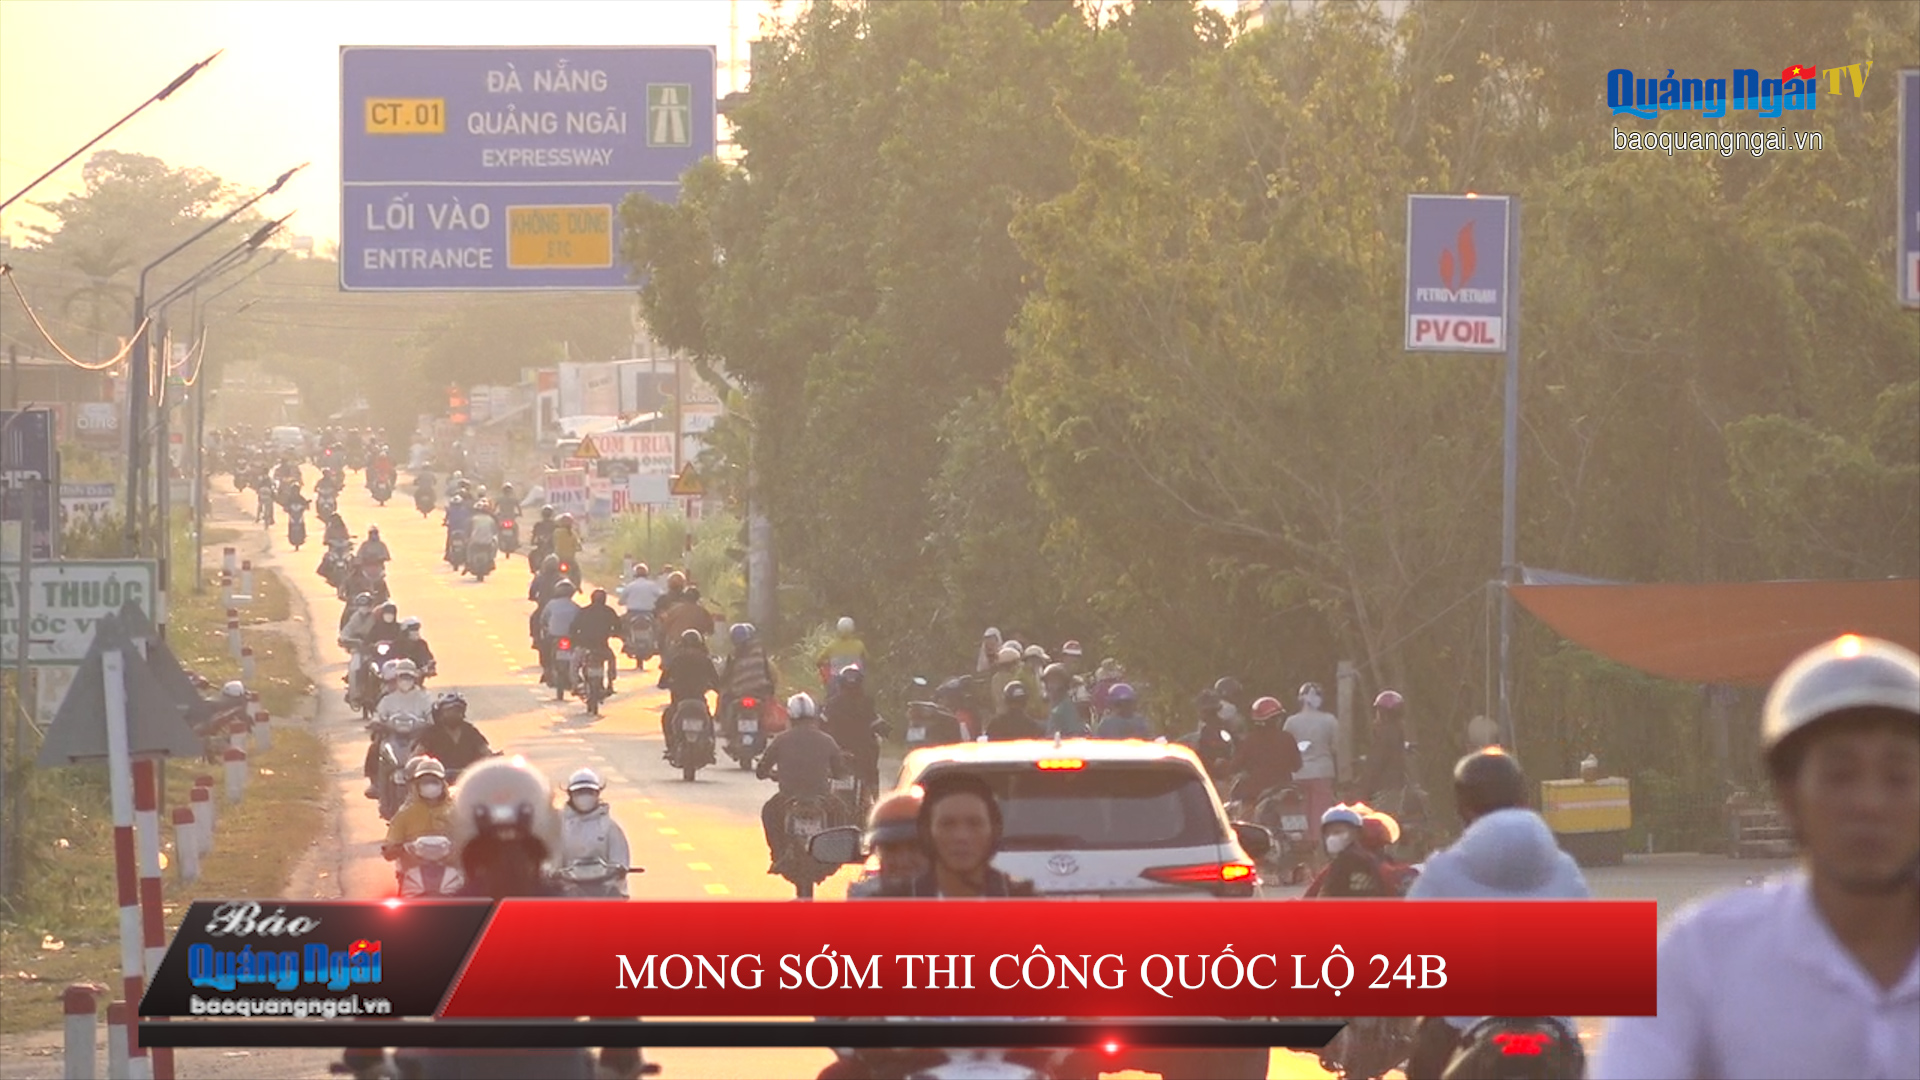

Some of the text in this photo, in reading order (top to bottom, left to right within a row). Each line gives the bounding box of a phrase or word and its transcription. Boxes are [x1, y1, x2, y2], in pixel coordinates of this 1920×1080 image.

[487, 62, 522, 92] ĐÀ
[371, 103, 440, 127] CT.01
[467, 103, 627, 135] QUẢNG NGÃI
[482, 148, 613, 168] EXPRESSWAY
[366, 192, 490, 230] LỐI VÀO
[363, 248, 493, 269] ENTRANCE
[42, 571, 143, 609] THUỐC
